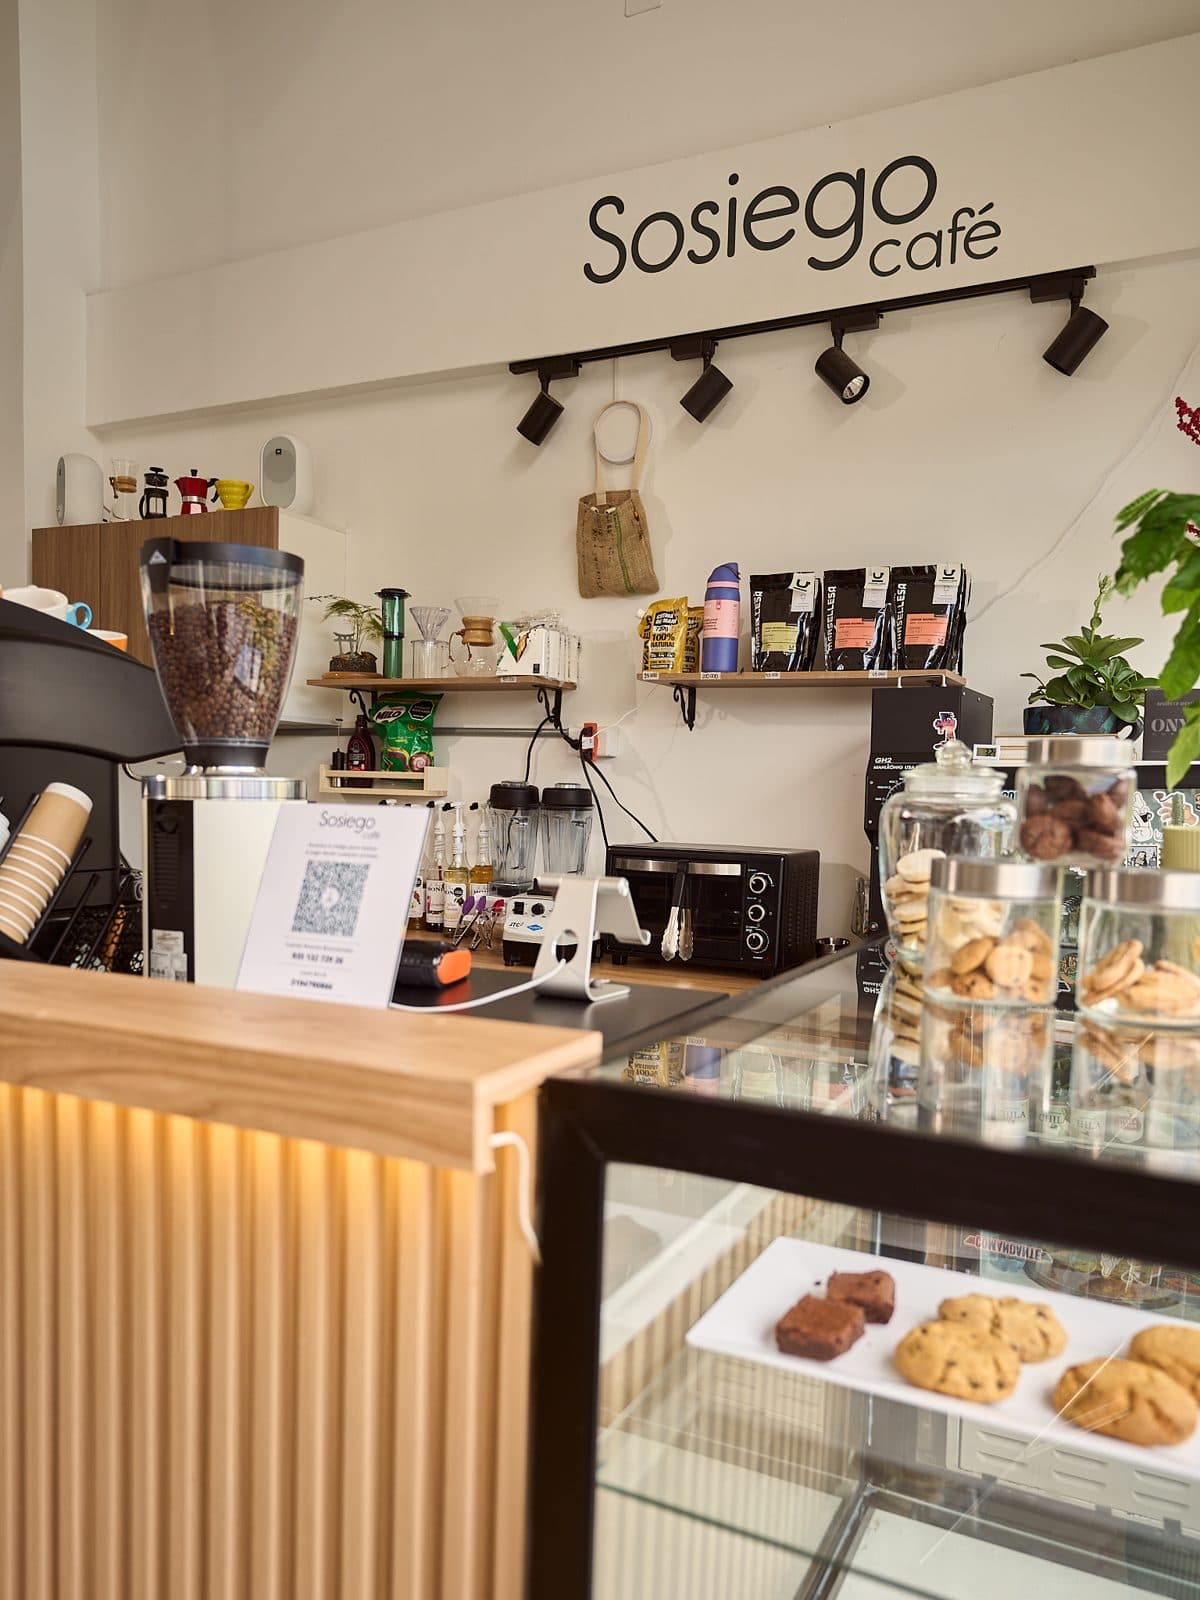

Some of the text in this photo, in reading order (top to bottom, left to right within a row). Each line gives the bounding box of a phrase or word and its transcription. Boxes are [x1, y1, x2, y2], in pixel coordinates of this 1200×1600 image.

[583, 155, 938, 284] Sosiego
[869, 202, 1001, 277] café
[652, 633, 675, 641] 100%
[318, 810, 377, 834] Sosiego
